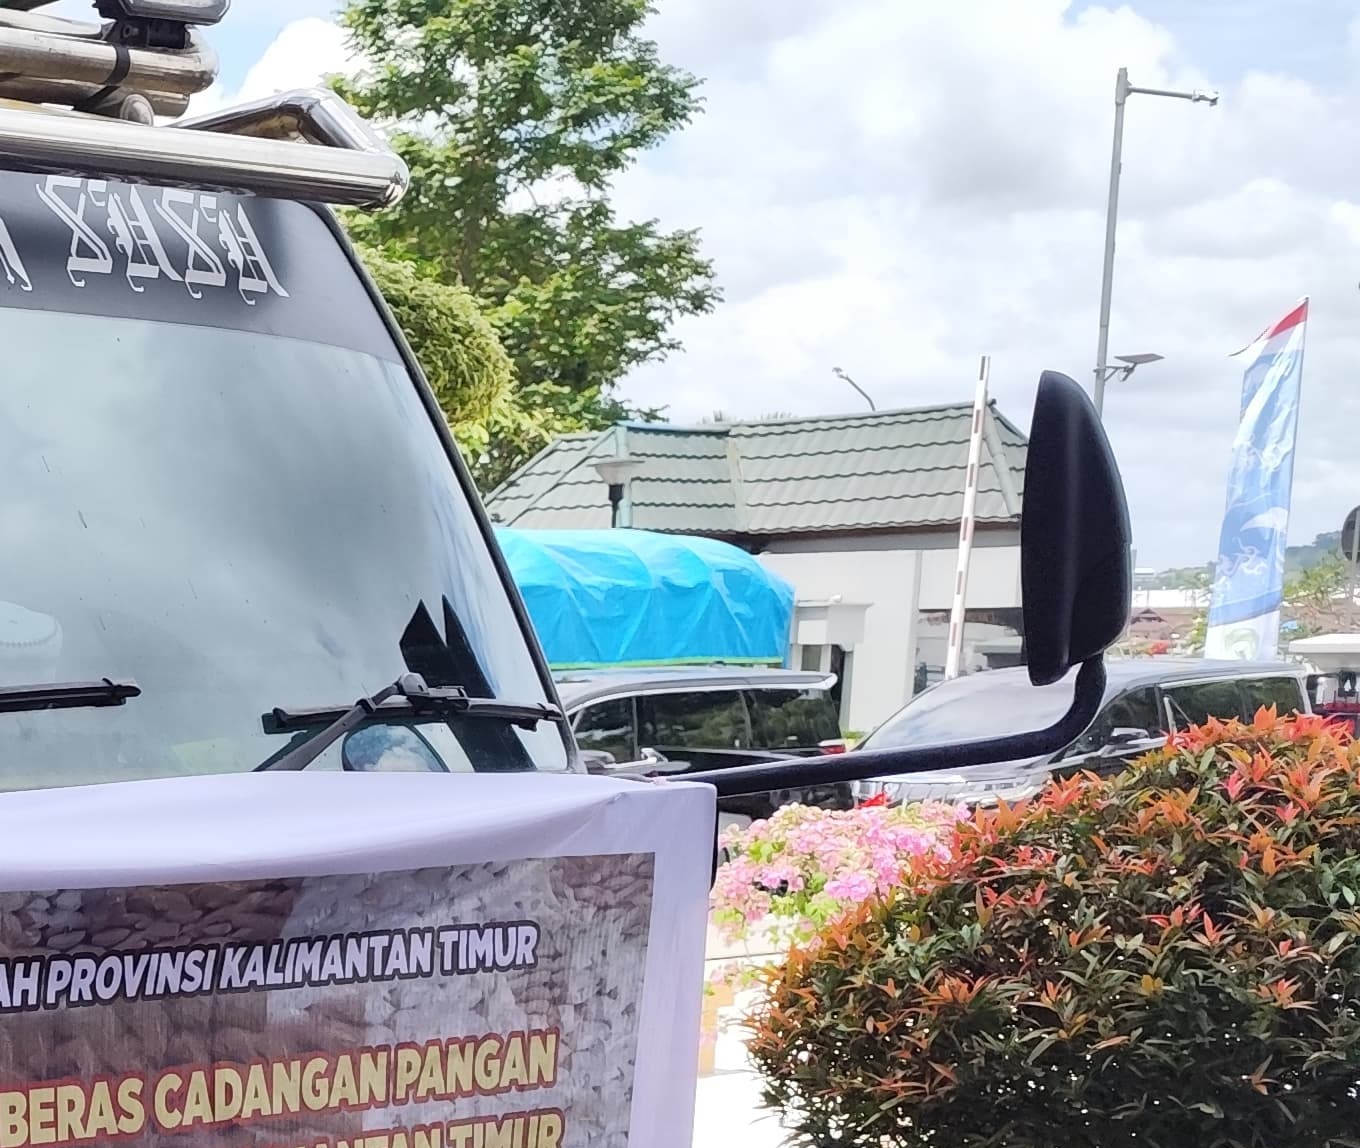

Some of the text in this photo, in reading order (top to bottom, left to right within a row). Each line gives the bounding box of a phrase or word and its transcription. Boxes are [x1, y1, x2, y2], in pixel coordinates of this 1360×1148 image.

[46, 950, 213, 1003] PROVINSI
[220, 939, 431, 989] KALIMANTAN
[439, 926, 539, 972] TIMUR
[0, 1078, 144, 1148] BERAS
[155, 1053, 392, 1125] CADANGAN
[396, 1035, 557, 1100] PANGAN
